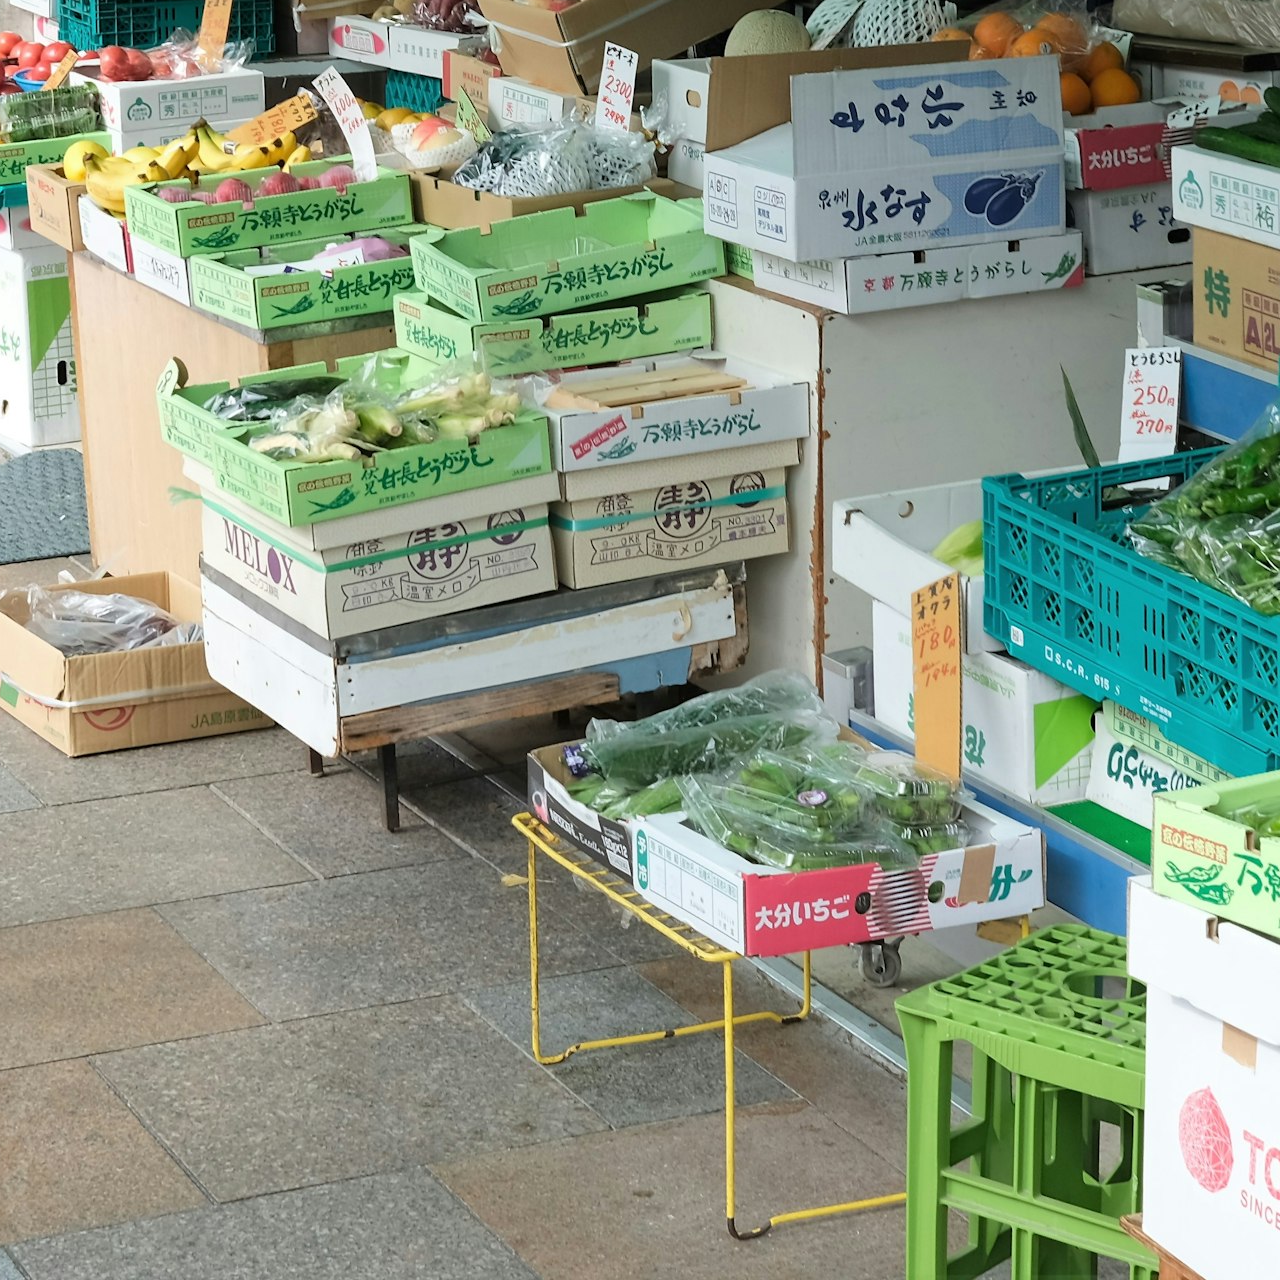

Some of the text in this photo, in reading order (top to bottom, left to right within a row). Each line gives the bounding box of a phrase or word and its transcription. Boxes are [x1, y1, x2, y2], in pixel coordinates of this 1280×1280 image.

[829, 84, 966, 134] 水なす
[1088, 144, 1152, 170] 大分いちご
[240, 194, 365, 231] 万願寺とうがらし
[842, 184, 928, 231] 水なす
[1215, 194, 1227, 216] 秀
[855, 229, 902, 247] JA全農大阪
[318, 269, 417, 306] 伏見甘長とうがら
[541, 247, 674, 296] 万願寺とうがらし
[863, 275, 895, 294] 京都
[899, 258, 1033, 293] 万願寺とうがらし
[1204, 266, 1232, 320] 特
[539, 317, 661, 355] 伏見甘長とうがらし
[1245, 315, 1280, 355] A 2L
[1131, 350, 1181, 368] とうもろこし
[1133, 385, 1175, 409] 250円
[641, 408, 761, 443] 万願寺とうがらし
[1136, 419, 1174, 435] 270円
[361, 447, 496, 497] 伏見甘長とうがらし
[222, 517, 298, 597] MELOX
[651, 533, 718, 559] 温室メロン
[917, 597, 951, 620] オクラ
[1055, 653, 1111, 691] S.C.R. 615
[1160, 823, 1228, 866] 京の伝統野菜
[754, 893, 851, 931] 大分いちご
